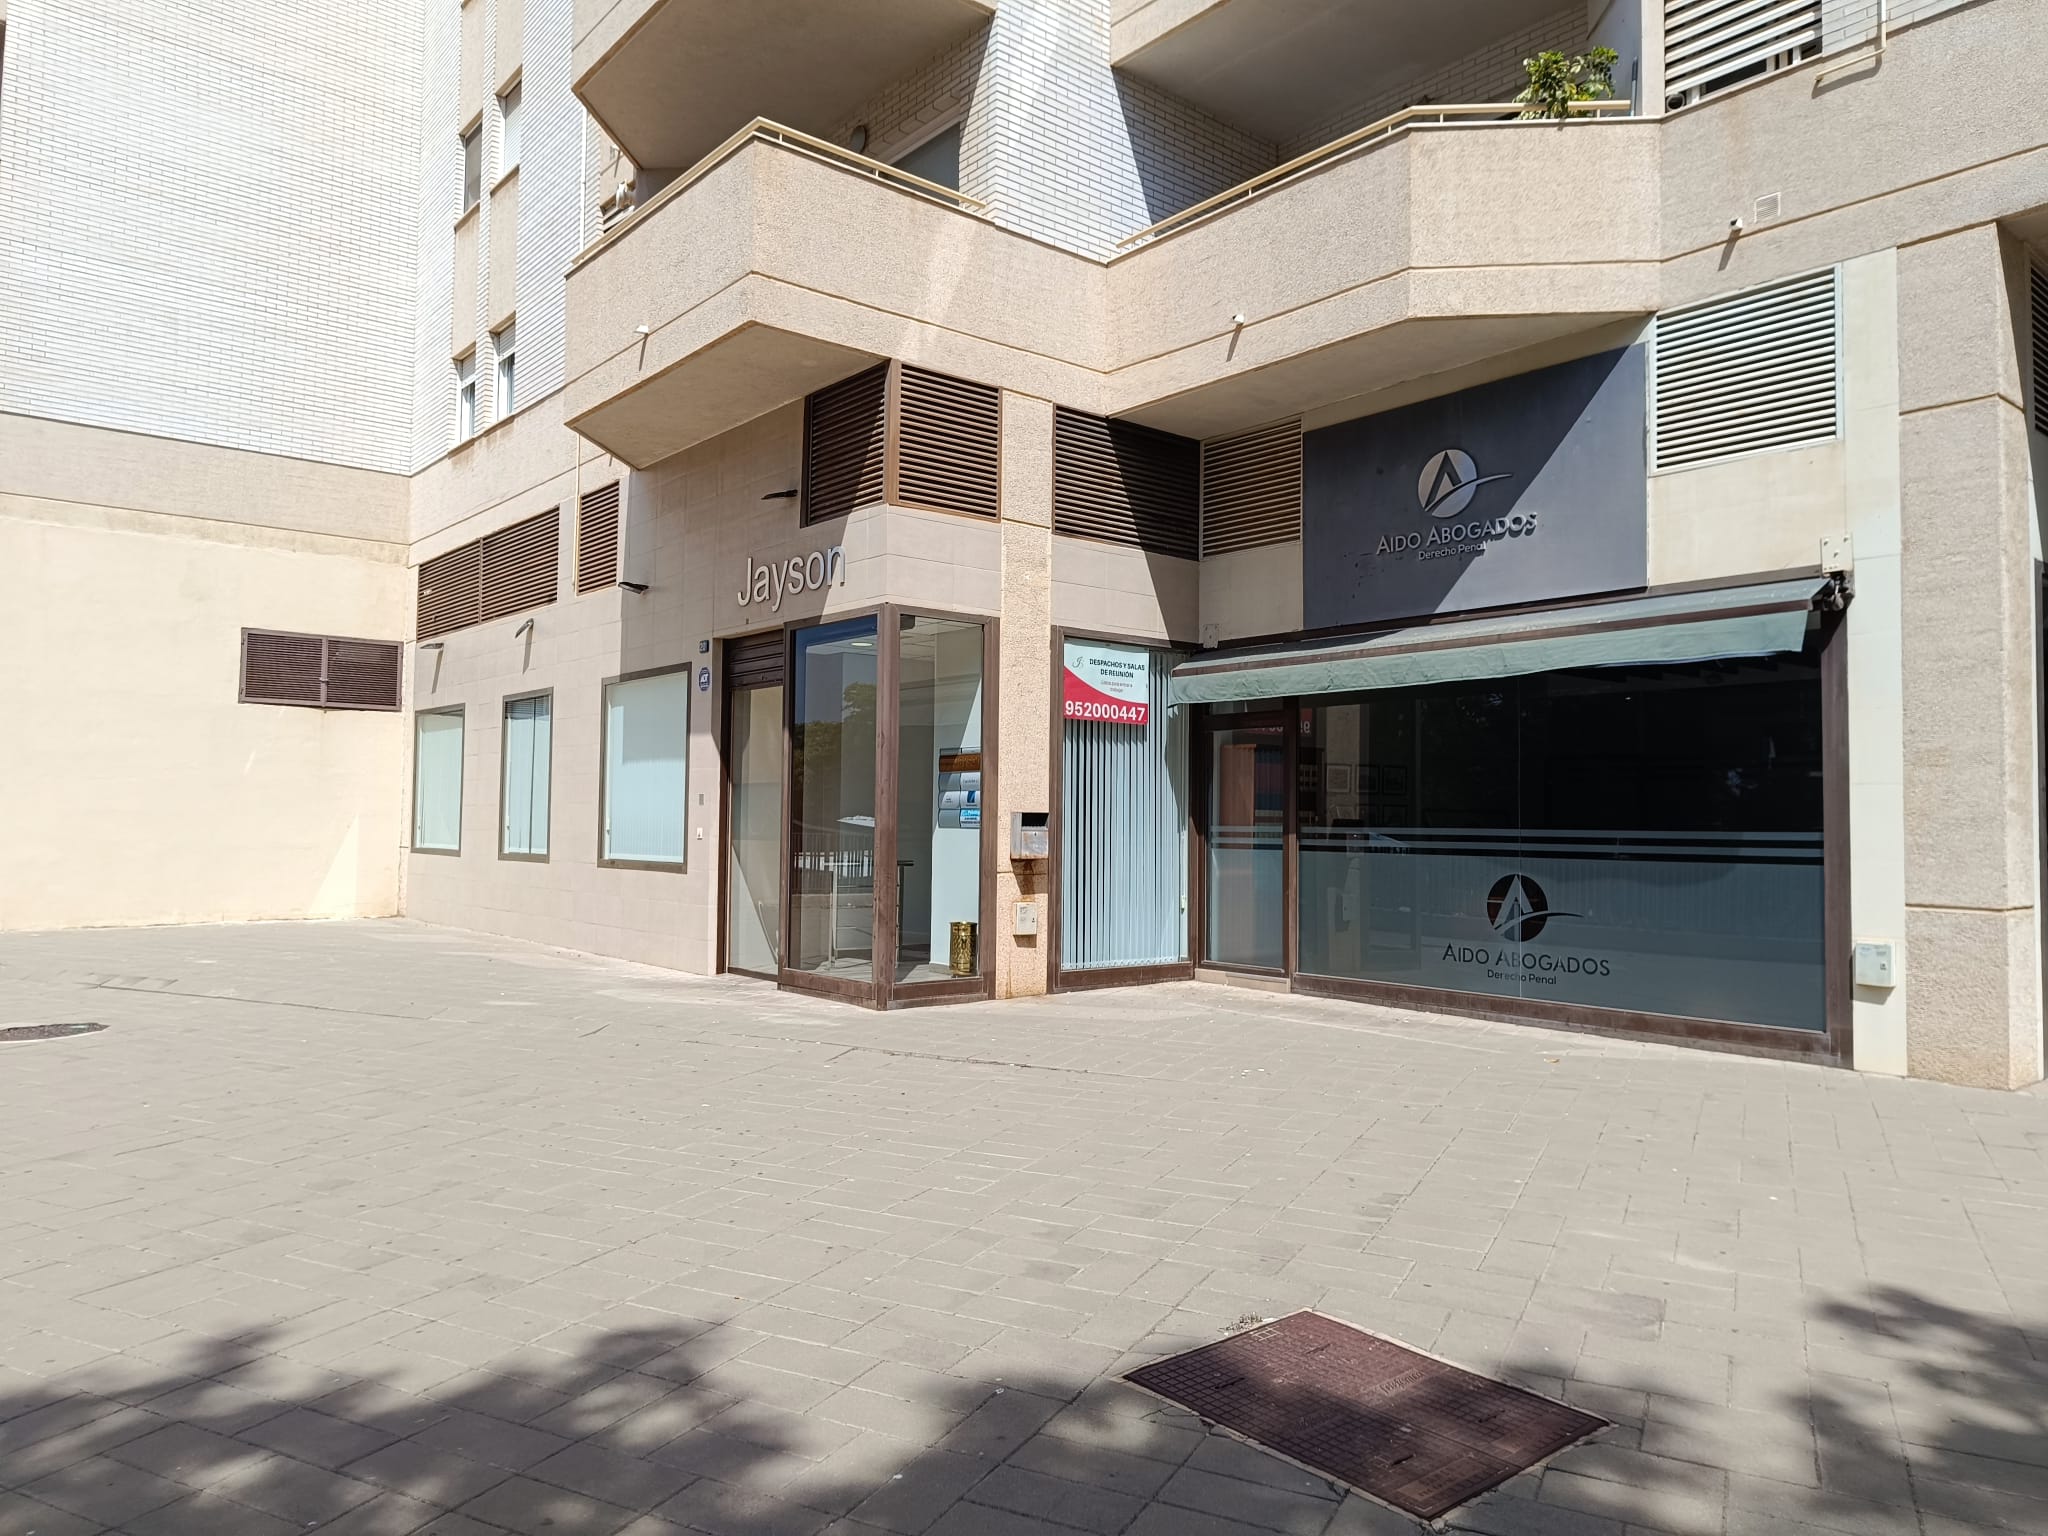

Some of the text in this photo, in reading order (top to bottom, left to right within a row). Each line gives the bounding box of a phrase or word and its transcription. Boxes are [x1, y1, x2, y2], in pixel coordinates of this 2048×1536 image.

[1376, 511, 1538, 555] AIDO ABOGADOS
[1418, 540, 1488, 561] Derecho Penal
[737, 545, 846, 613] Jayson
[1089, 658, 1123, 669] DESPACHOS
[1127, 663, 1145, 671] SALAS
[1100, 668, 1134, 678] DE REUNIÓN
[1065, 700, 1146, 722] 952000447
[1442, 942, 1611, 977] AIDO ABOGADOS
[1487, 969, 1557, 985] Derecho Penal
